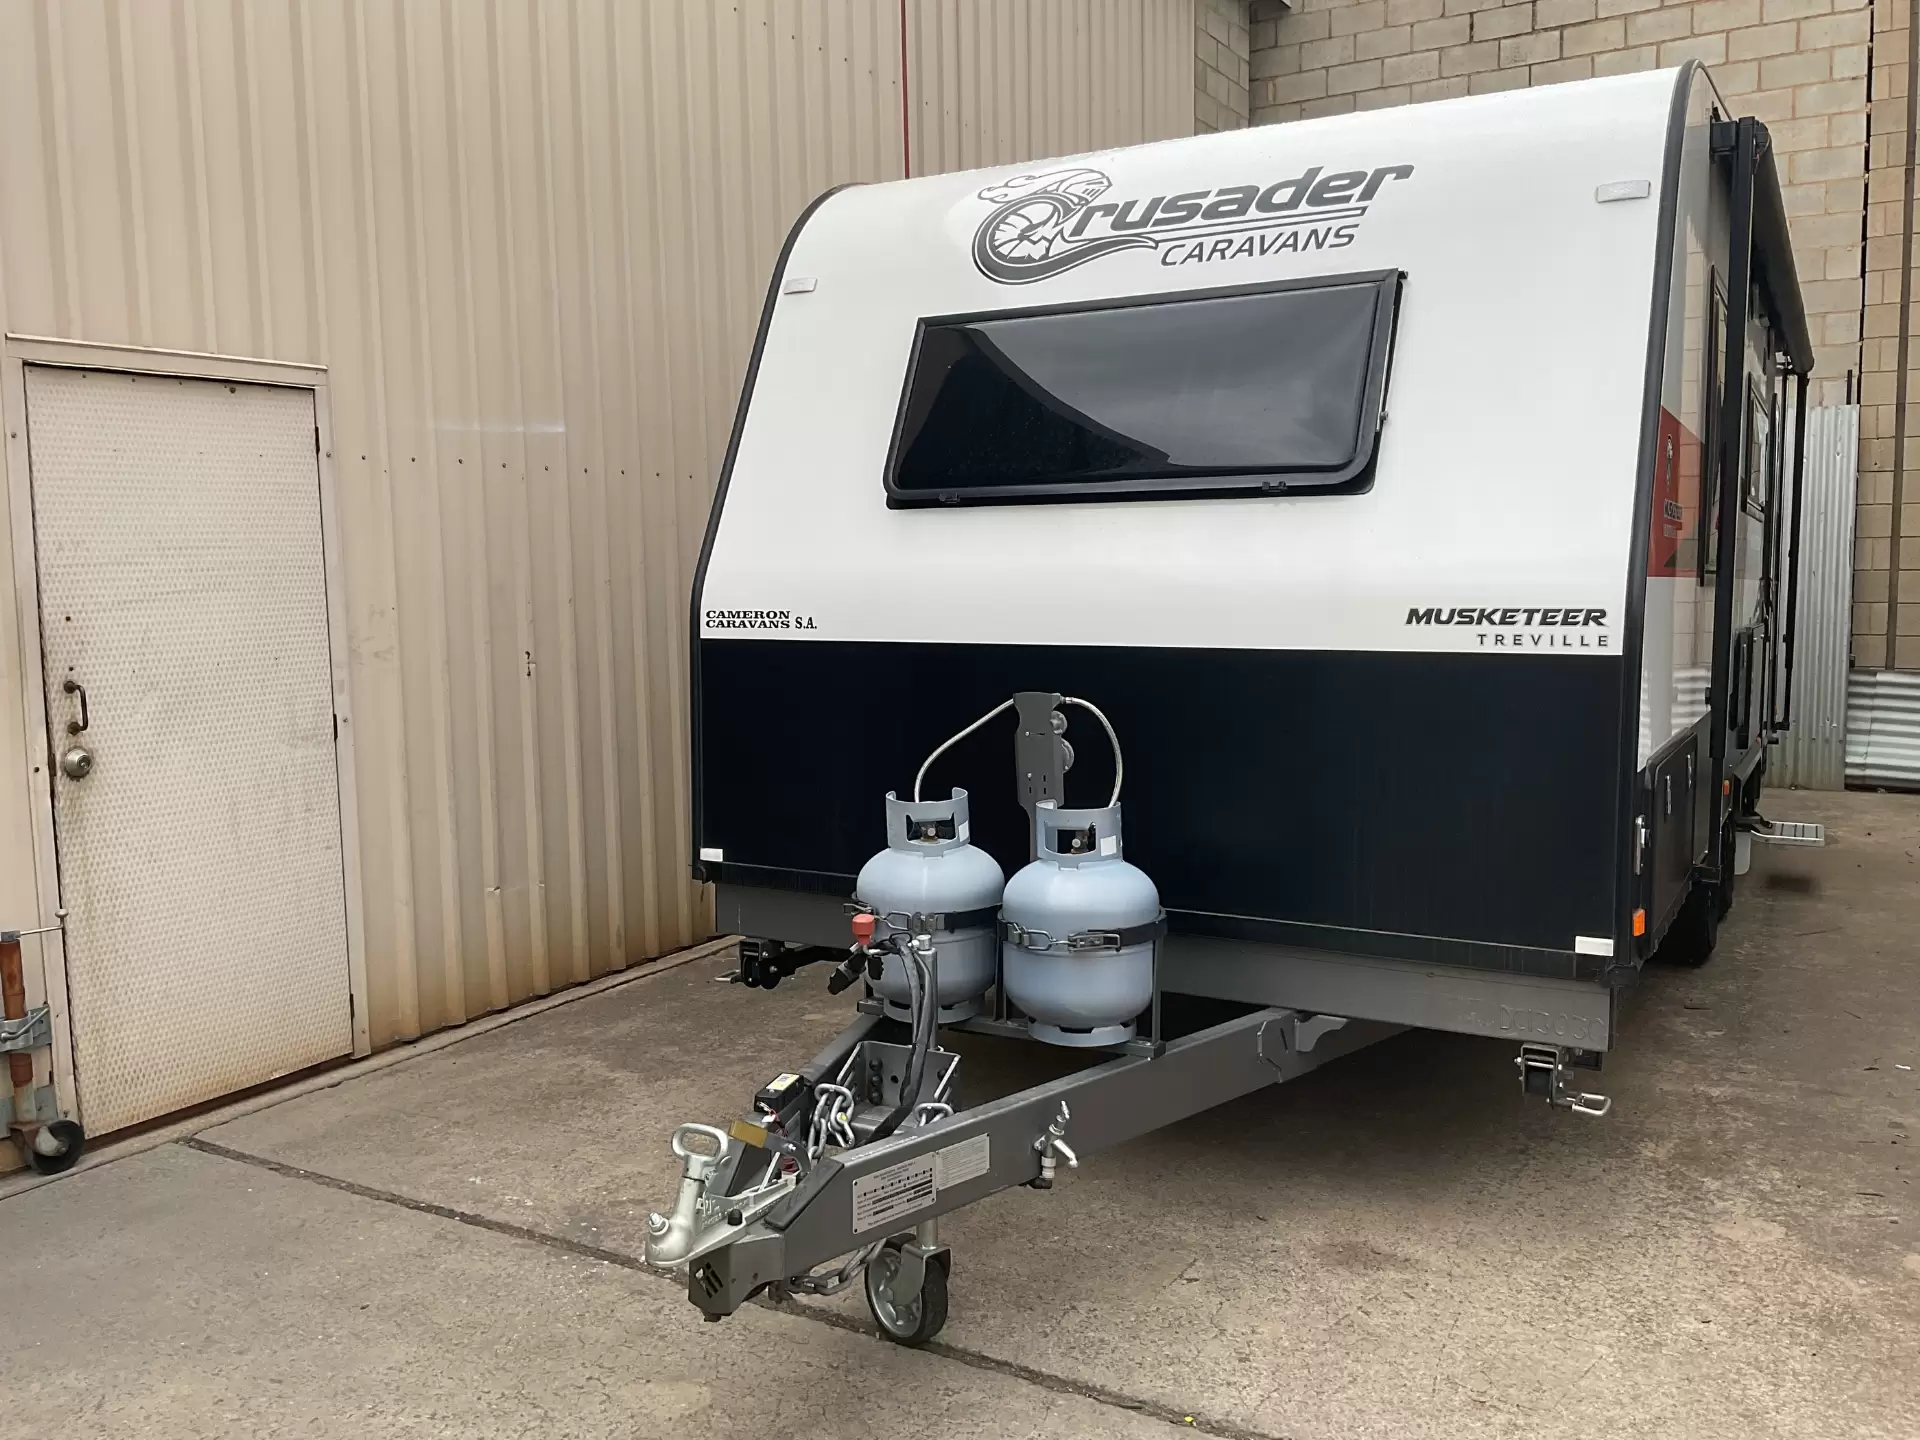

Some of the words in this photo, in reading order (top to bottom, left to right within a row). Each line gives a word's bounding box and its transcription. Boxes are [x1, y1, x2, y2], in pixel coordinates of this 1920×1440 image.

[972, 164, 1414, 285] Crusader
[1160, 223, 1357, 266] CARAVANS
[705, 610, 791, 619] CAMERON
[705, 619, 791, 629] CARAVANS
[794, 616, 818, 629] S.A.
[1405, 608, 1609, 627] MUSKETEER
[1477, 634, 1609, 647] TREVILLE
